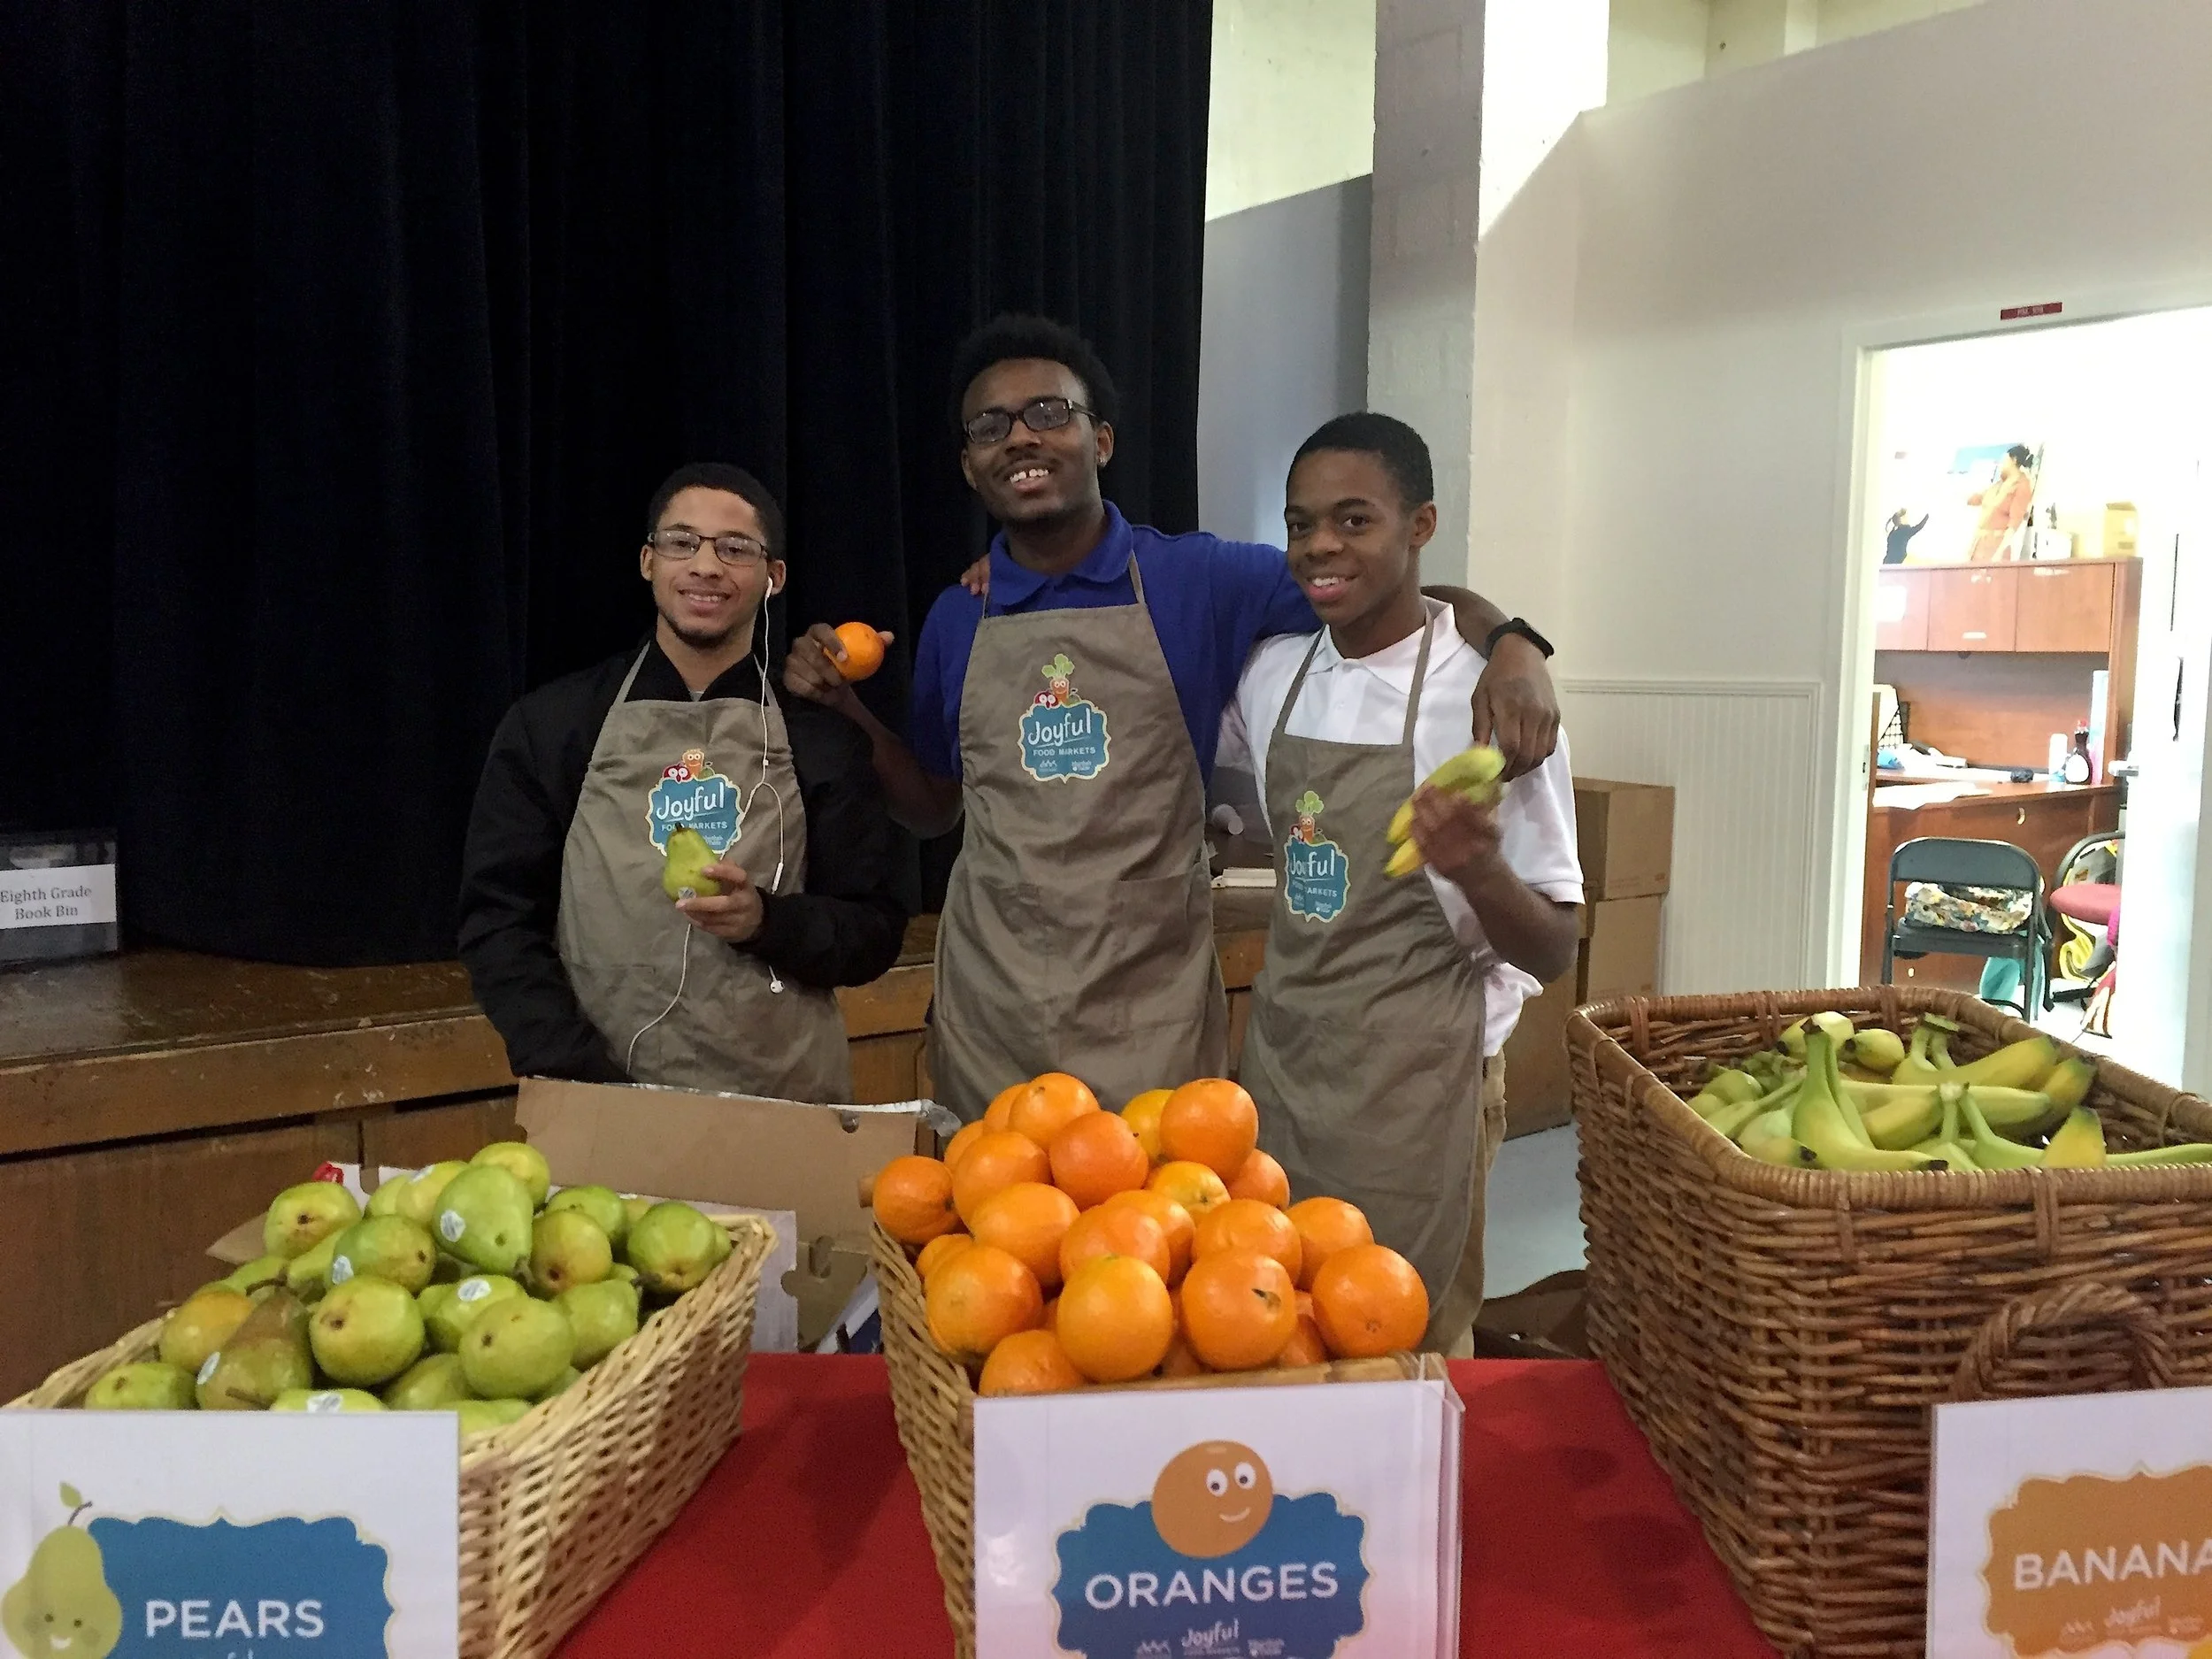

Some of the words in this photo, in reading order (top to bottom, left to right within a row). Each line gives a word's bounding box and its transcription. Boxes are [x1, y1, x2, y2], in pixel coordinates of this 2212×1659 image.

[1028, 708, 1091, 746] Joyful
[1058, 746, 1096, 756] MARKETS
[656, 781, 725, 821] Joyful
[0, 888, 47, 905] Eighth
[50, 886, 92, 899] Grade
[1305, 887, 1338, 898] ARKETS
[15, 906, 51, 920] Book
[56, 905, 79, 918] Bin
[1084, 1562, 1339, 1610] ORANGES
[145, 1600, 325, 1640] PEARS
